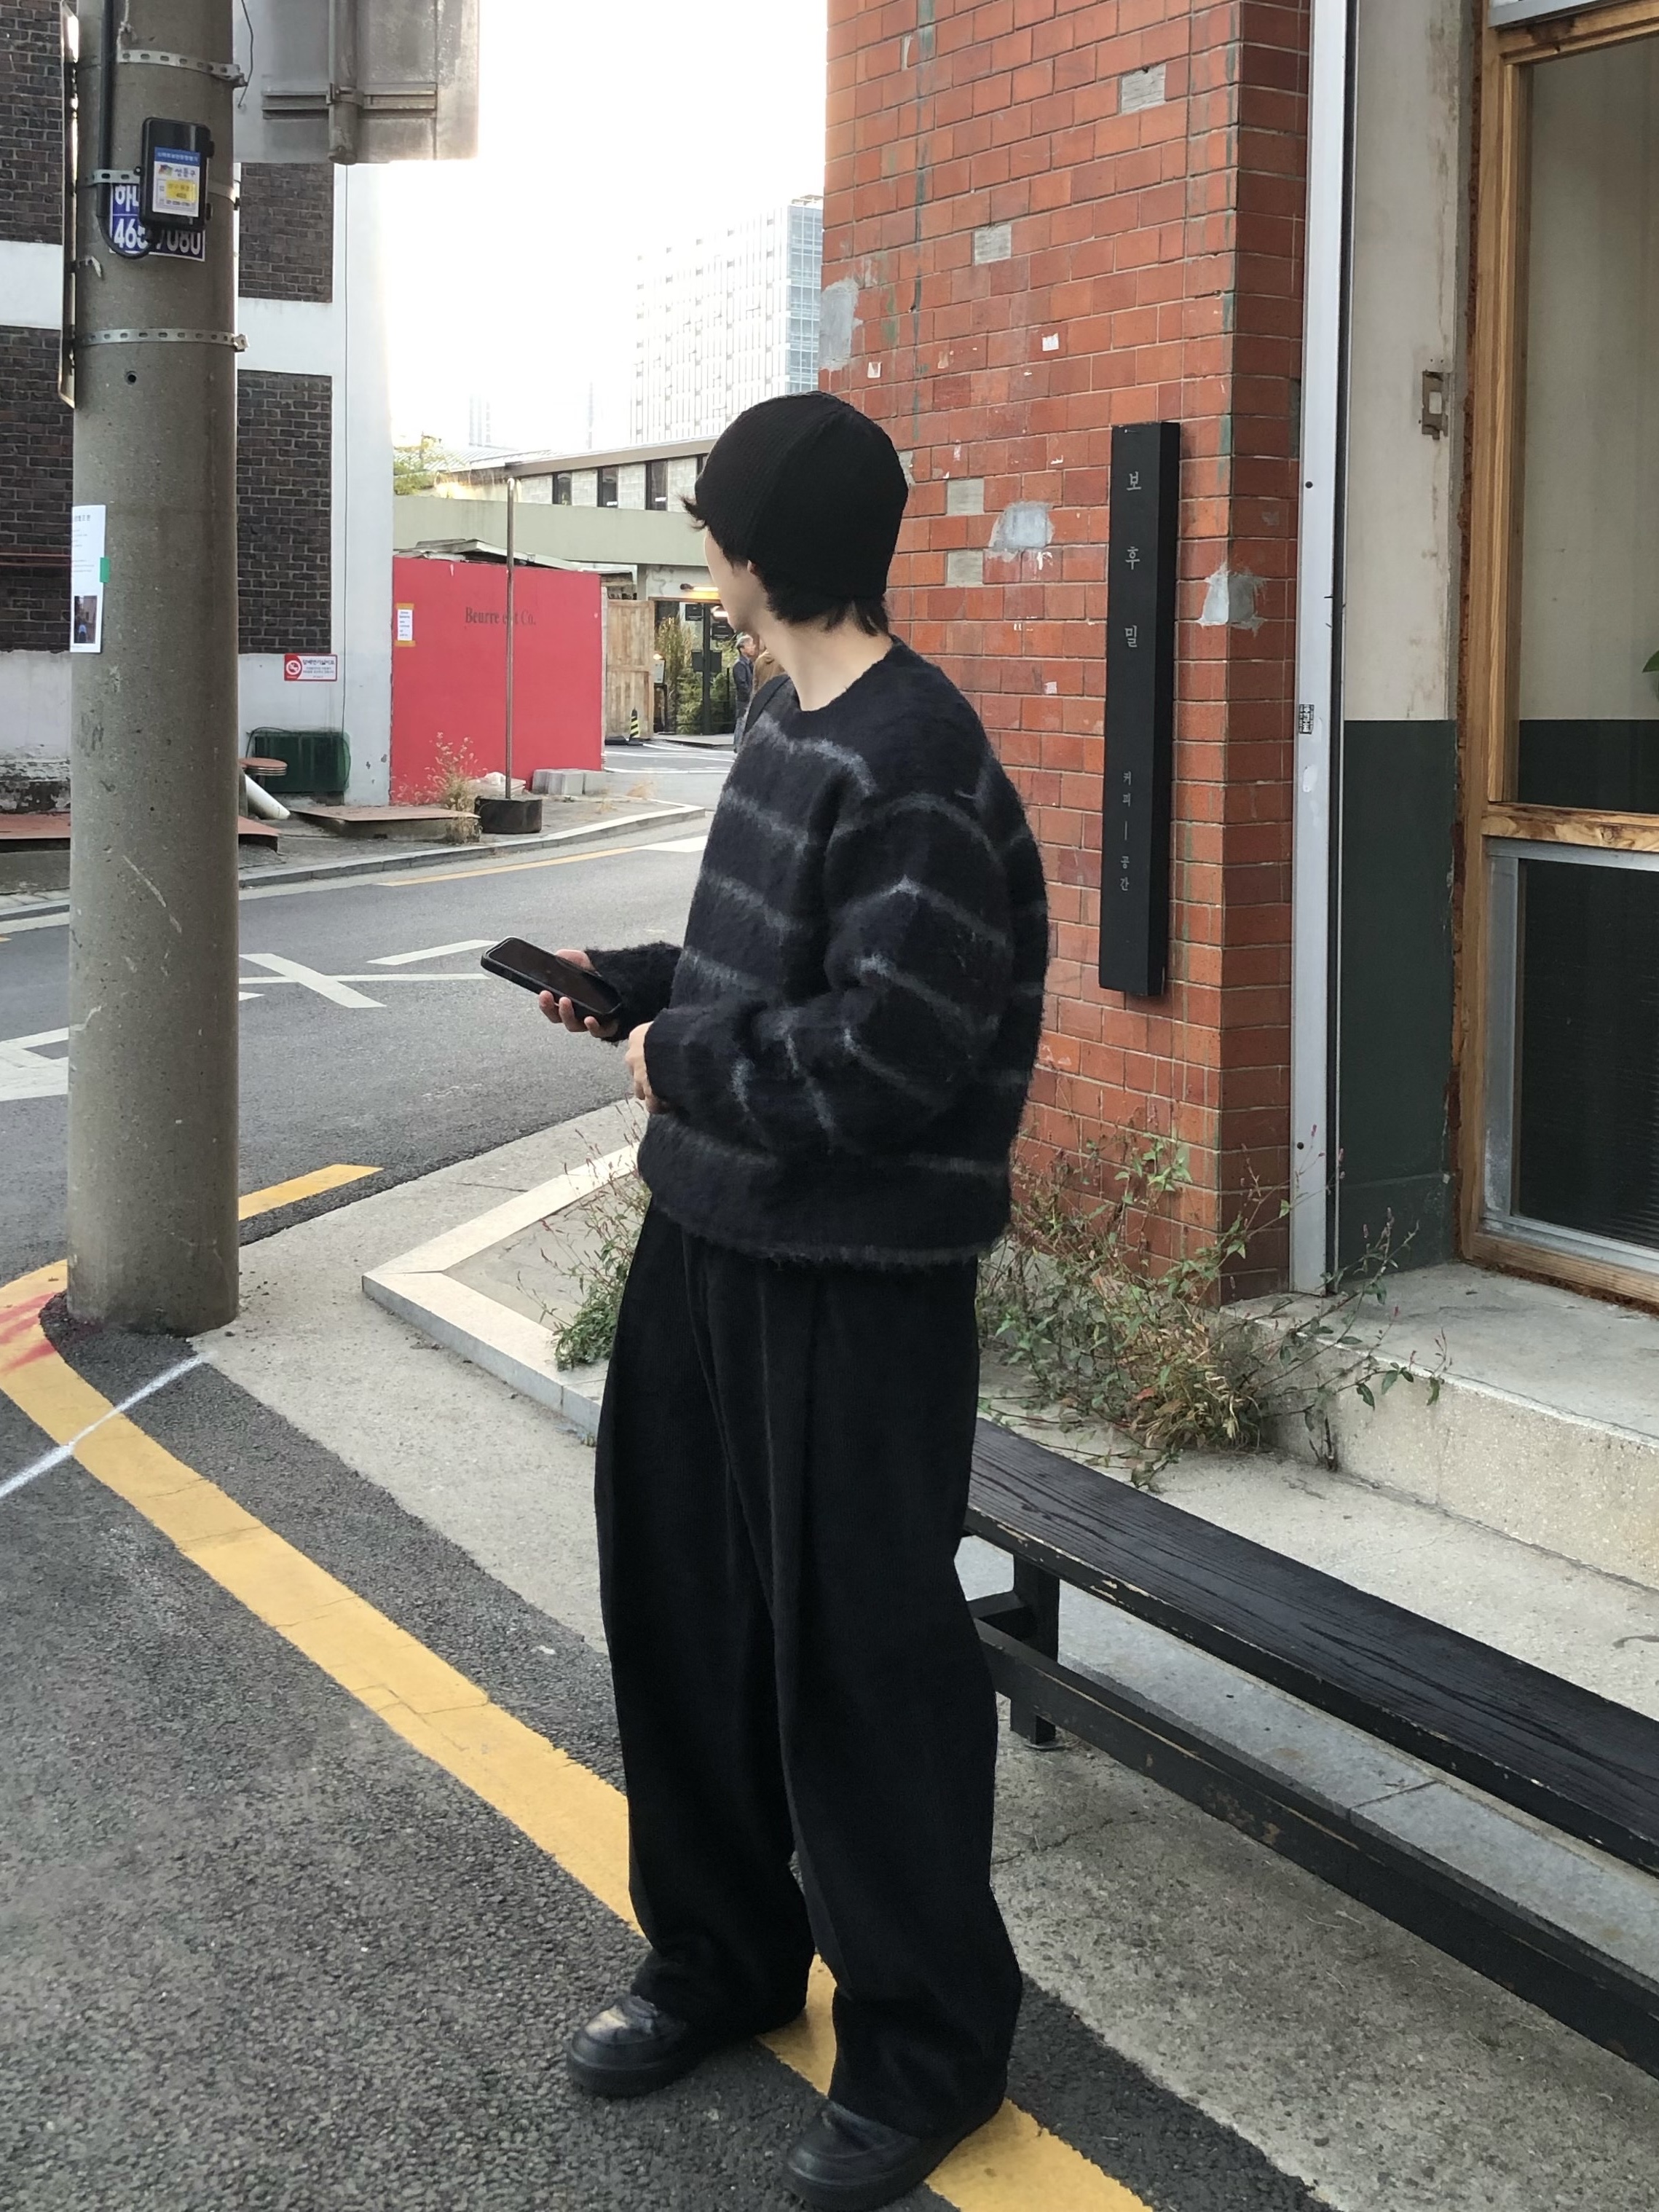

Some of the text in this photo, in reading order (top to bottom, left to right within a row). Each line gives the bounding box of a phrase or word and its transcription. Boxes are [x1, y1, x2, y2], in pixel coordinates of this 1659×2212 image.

[465, 606, 500, 624] Beurre
[1119, 771, 1132, 892] 커피 공간
